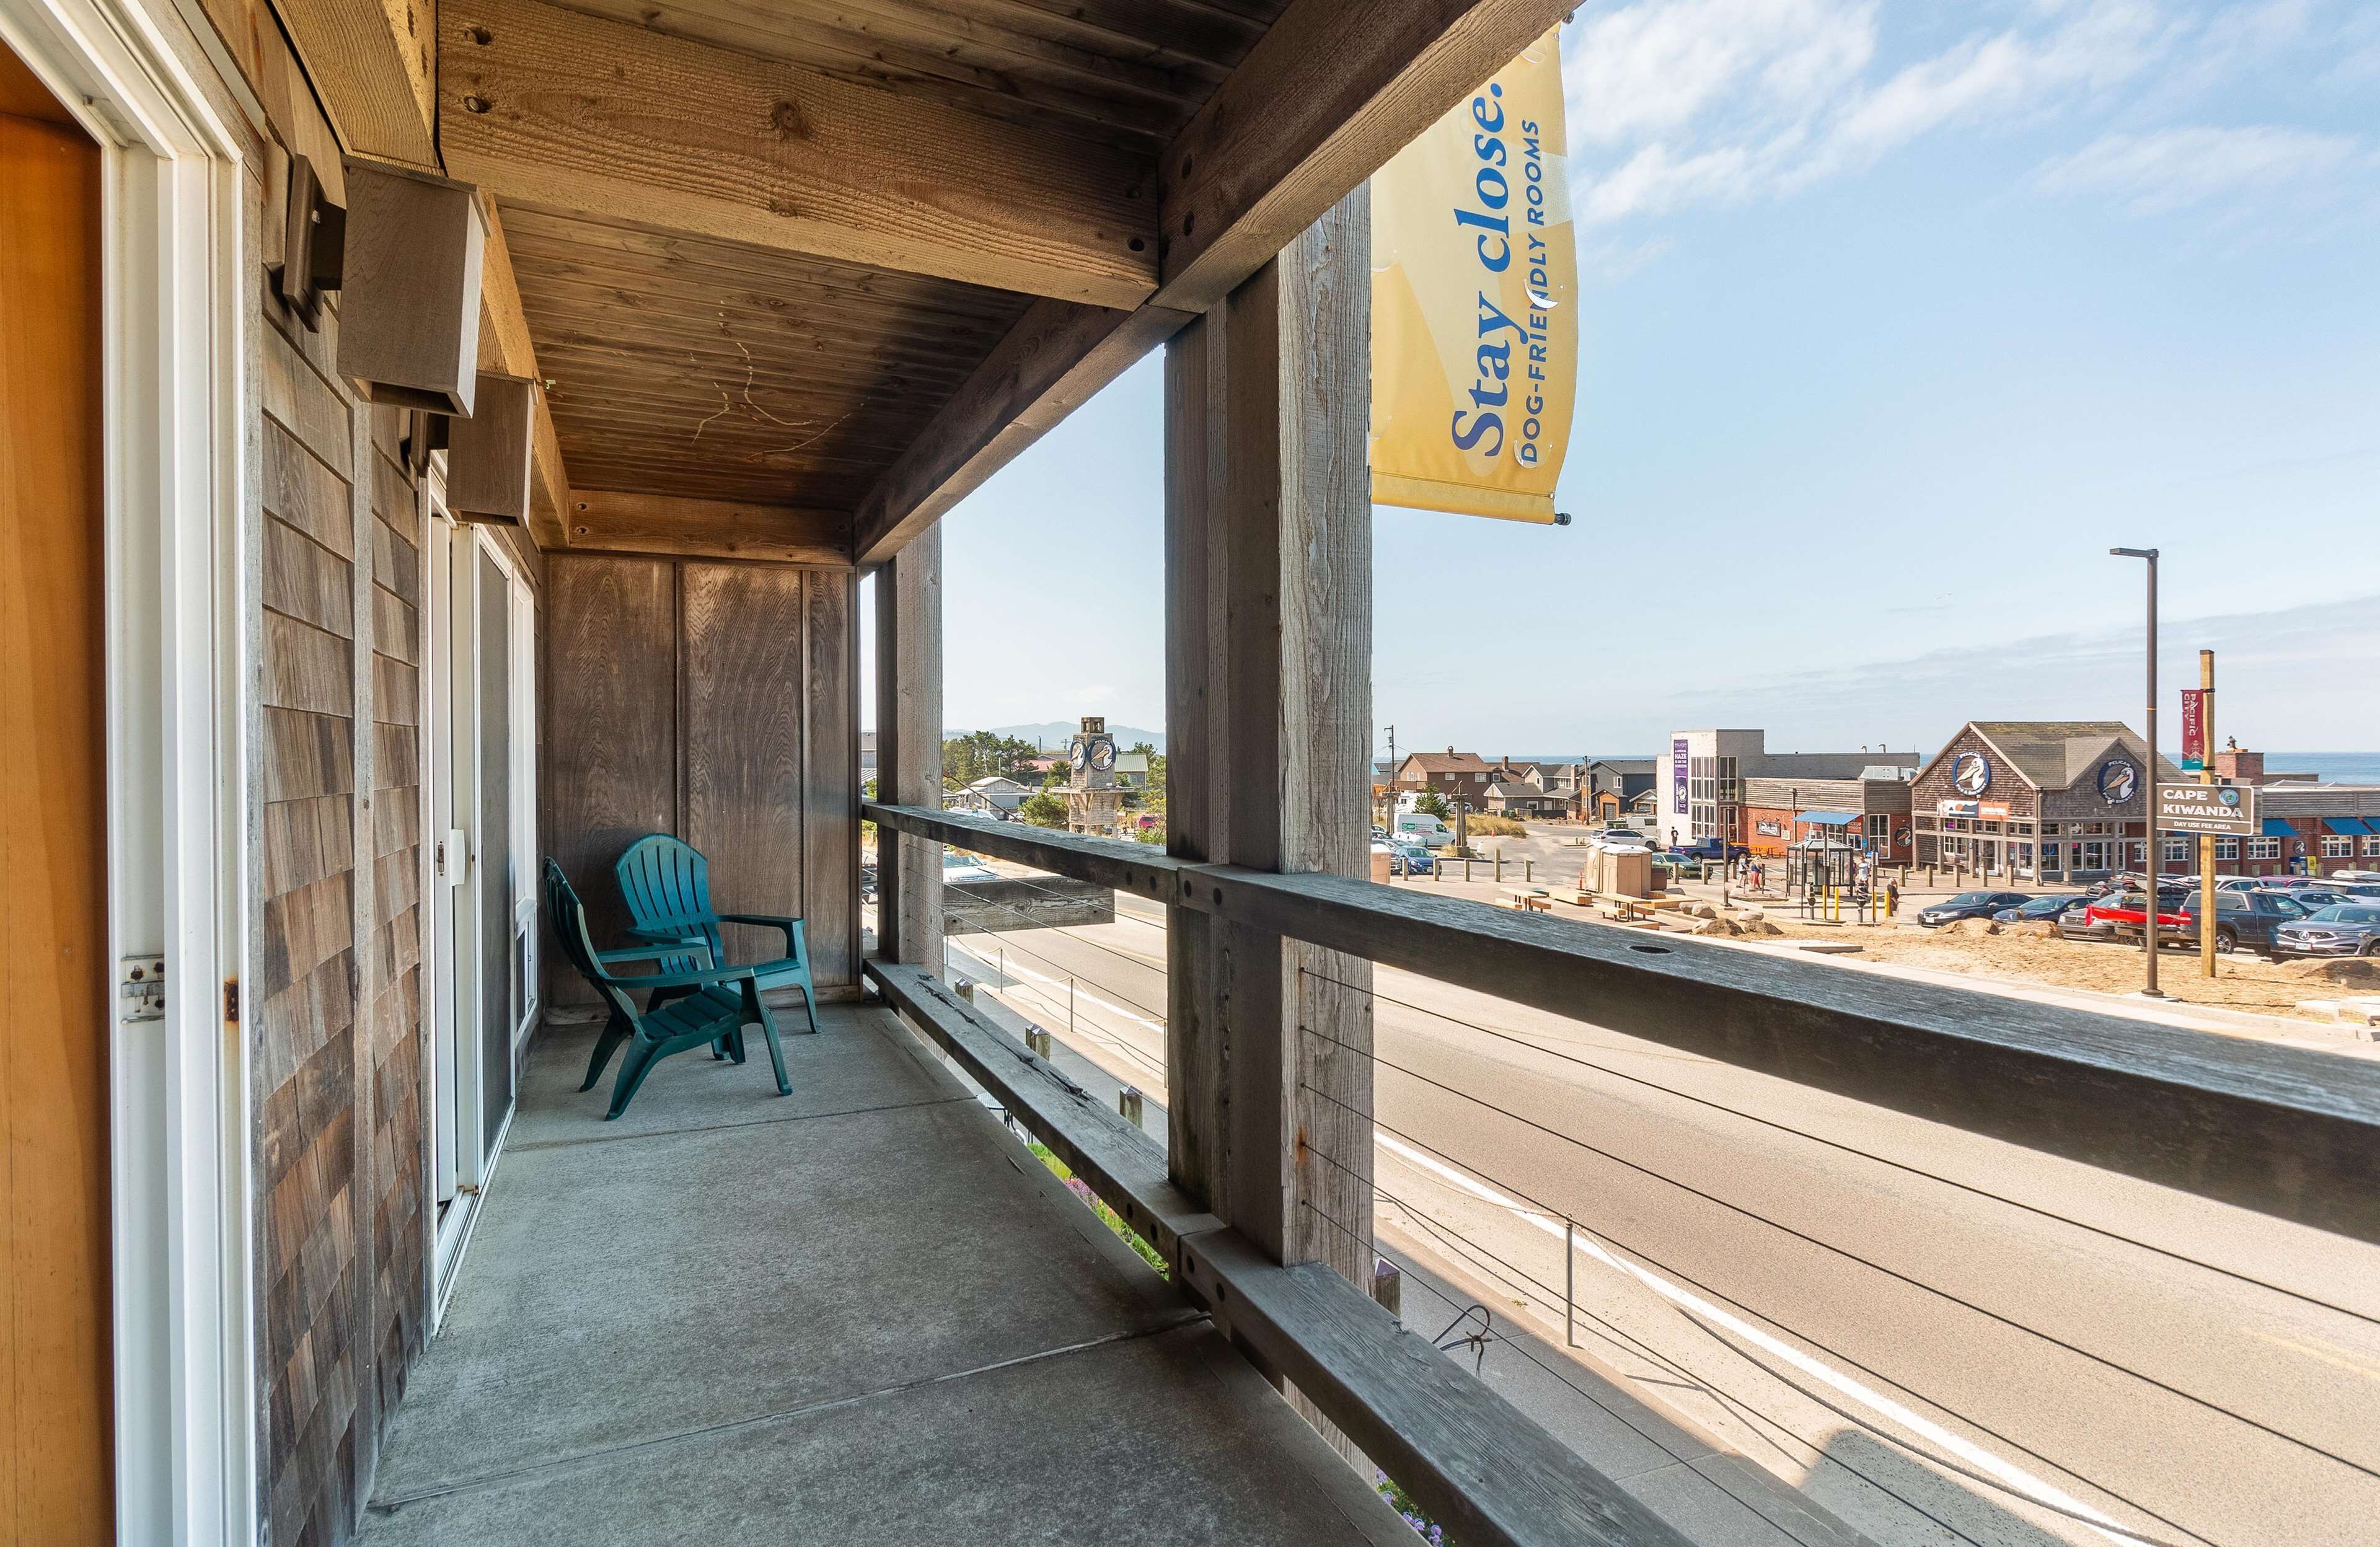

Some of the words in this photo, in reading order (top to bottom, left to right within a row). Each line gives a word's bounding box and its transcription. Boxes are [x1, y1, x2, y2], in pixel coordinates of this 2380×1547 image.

[1453, 83, 1511, 273] close.
[1522, 119, 1545, 226] ROOMS
[1452, 291, 1528, 457] Stay
[2188, 694, 2198, 736] PACIFIC
[2162, 789, 2208, 801] CAPE
[2162, 804, 2244, 818] KIWANDA
